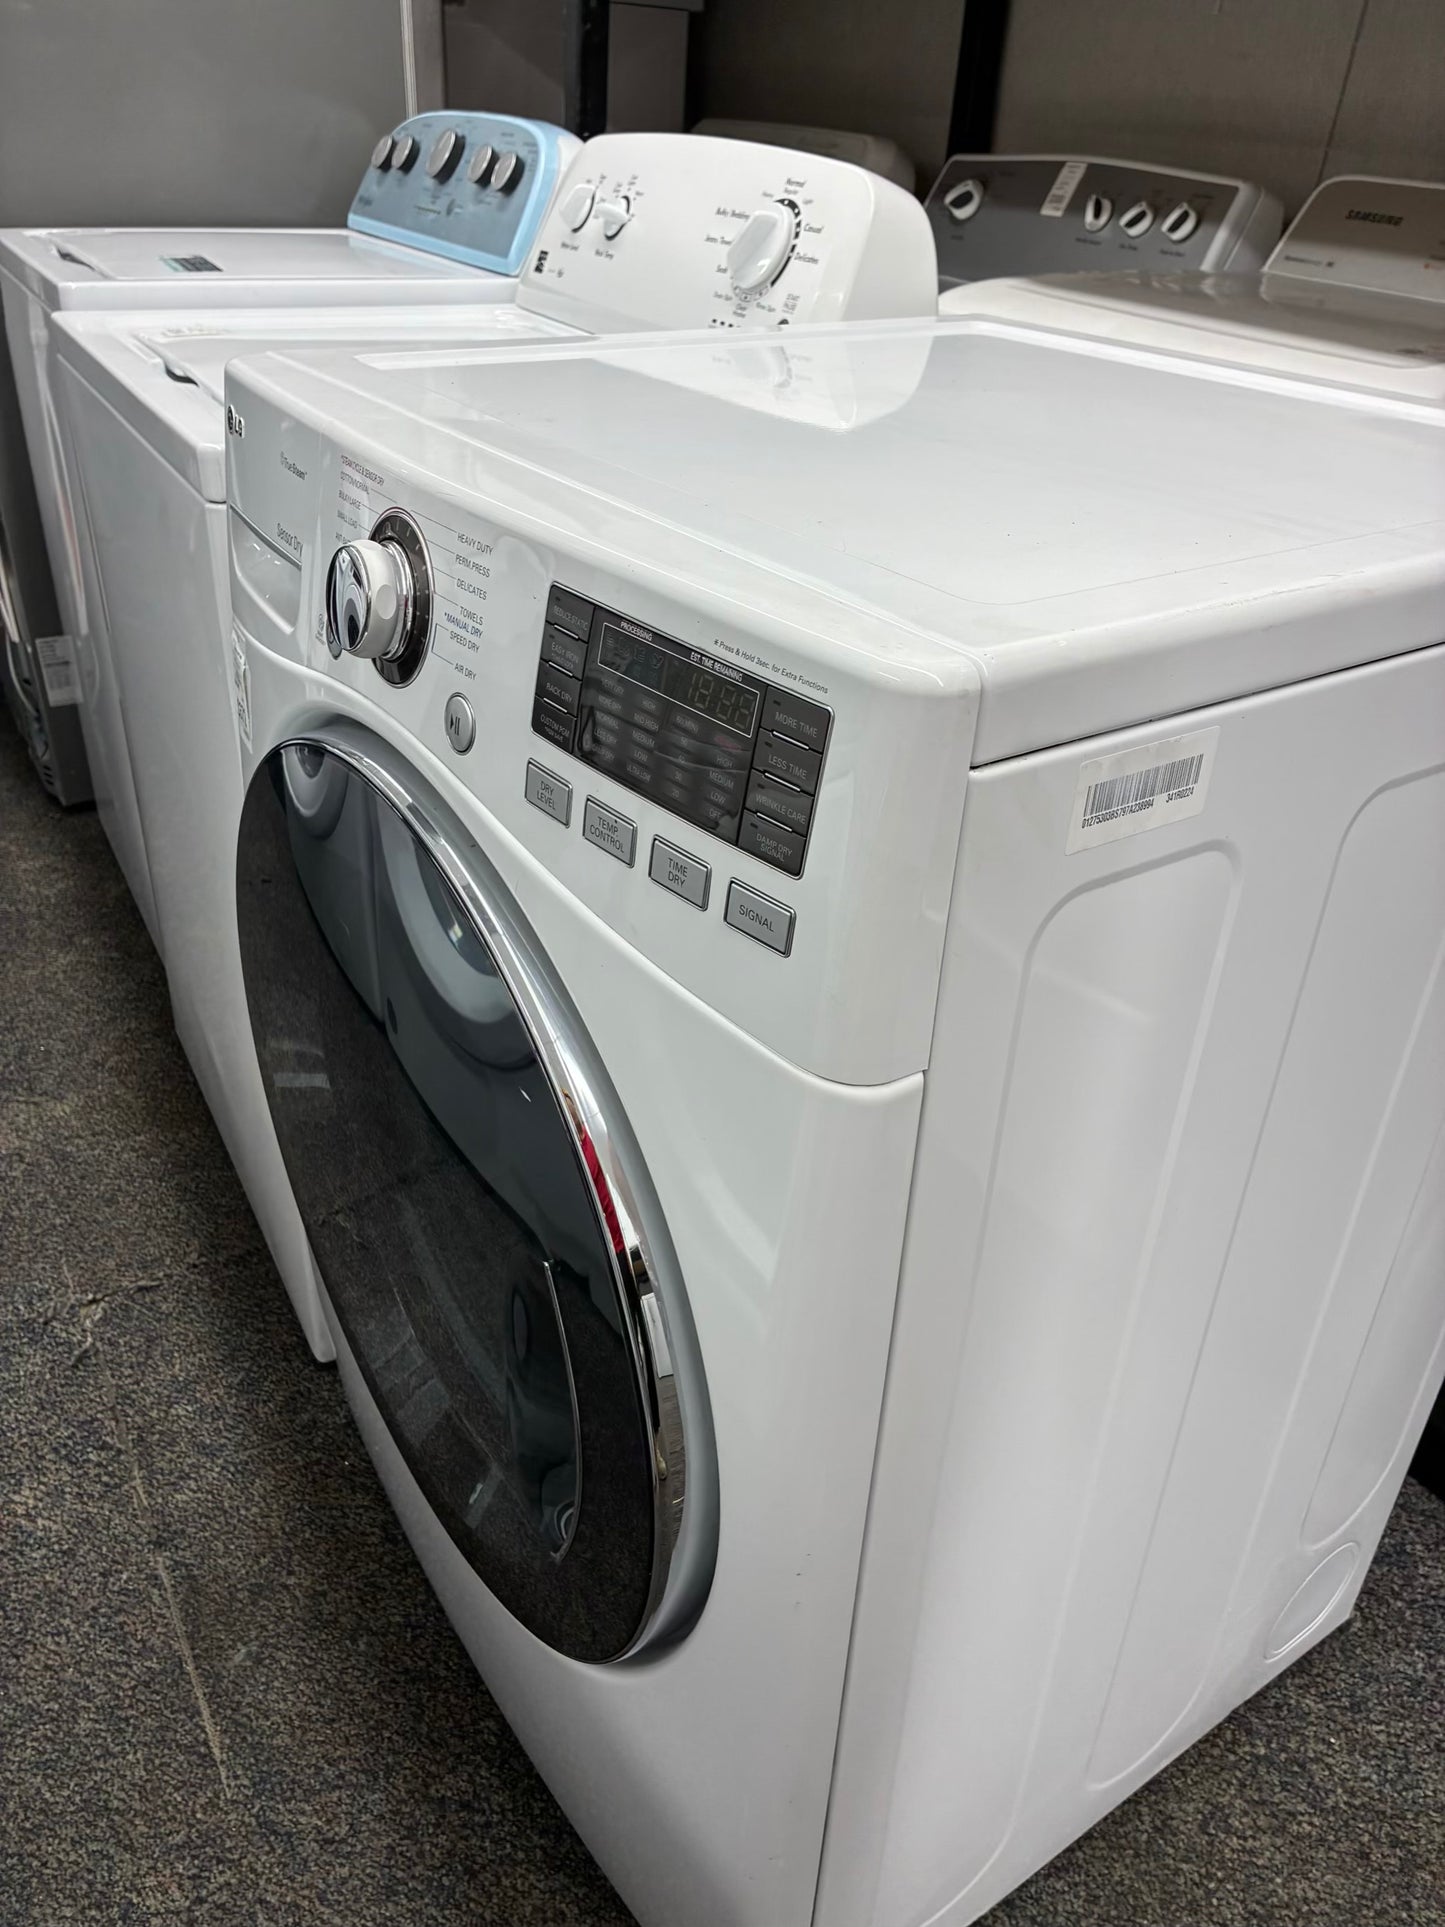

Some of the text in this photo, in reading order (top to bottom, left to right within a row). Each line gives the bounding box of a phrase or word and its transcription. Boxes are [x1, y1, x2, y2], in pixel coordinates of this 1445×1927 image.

[1345, 209, 1404, 226] SAMSUNG
[457, 532, 494, 556] HEAVY DUTY
[456, 578, 488, 601] DELICATES
[460, 605, 484, 626] TOWELS
[449, 630, 481, 654] SPEED DRY
[470, 625, 484, 639] DRY
[620, 621, 653, 642] PROCESSING
[454, 662, 477, 681] AIR DRY
[701, 656, 714, 669] TIME
[713, 661, 743, 682] REMAINING
[735, 647, 741, 656] &
[740, 651, 756, 666] Hold
[771, 663, 781, 674] for
[781, 668, 797, 681] Extra
[798, 675, 829, 694] Functions
[775, 711, 818, 738] MORE TIME
[768, 754, 808, 779] LESS TIME
[540, 781, 555, 796] DRY
[709, 770, 735, 789] MEDIUM
[536, 790, 556, 811] LEVEL
[755, 793, 807, 825] WRINKLE CARE
[589, 824, 625, 854] CONTROL
[756, 833, 793, 857] DAMP DRY
[760, 843, 784, 862] SIGNAL
[668, 857, 688, 878] TIME
[667, 870, 686, 889] DRY
[739, 904, 775, 932] SIGNAL
